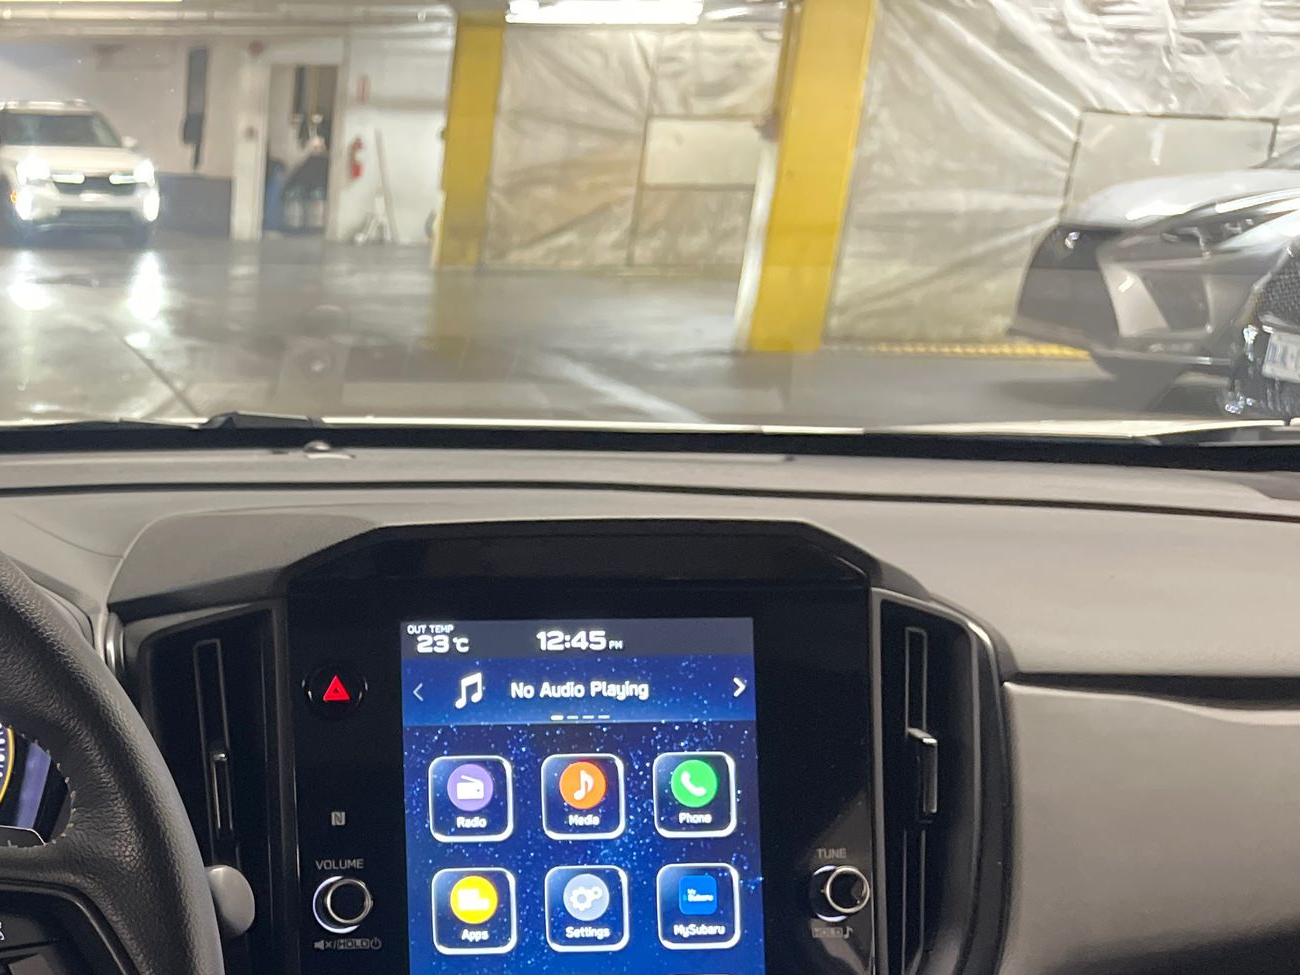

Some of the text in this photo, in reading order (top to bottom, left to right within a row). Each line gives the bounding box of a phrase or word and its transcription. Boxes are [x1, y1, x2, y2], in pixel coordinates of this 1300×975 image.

[407, 624, 454, 635] OUT TEMP
[416, 634, 450, 653] 23
[536, 630, 623, 651] 12:45 PM
[510, 680, 649, 701] No Audio Playing
[456, 816, 488, 829] Radio
[568, 814, 600, 827] Media
[679, 812, 712, 825] Phone
[816, 848, 847, 859] TUNE
[315, 858, 364, 871] VOLUME
[461, 928, 489, 943] Apps
[565, 925, 611, 940] Settings
[673, 923, 726, 937] MySubaru
[337, 938, 370, 950] HOLD
